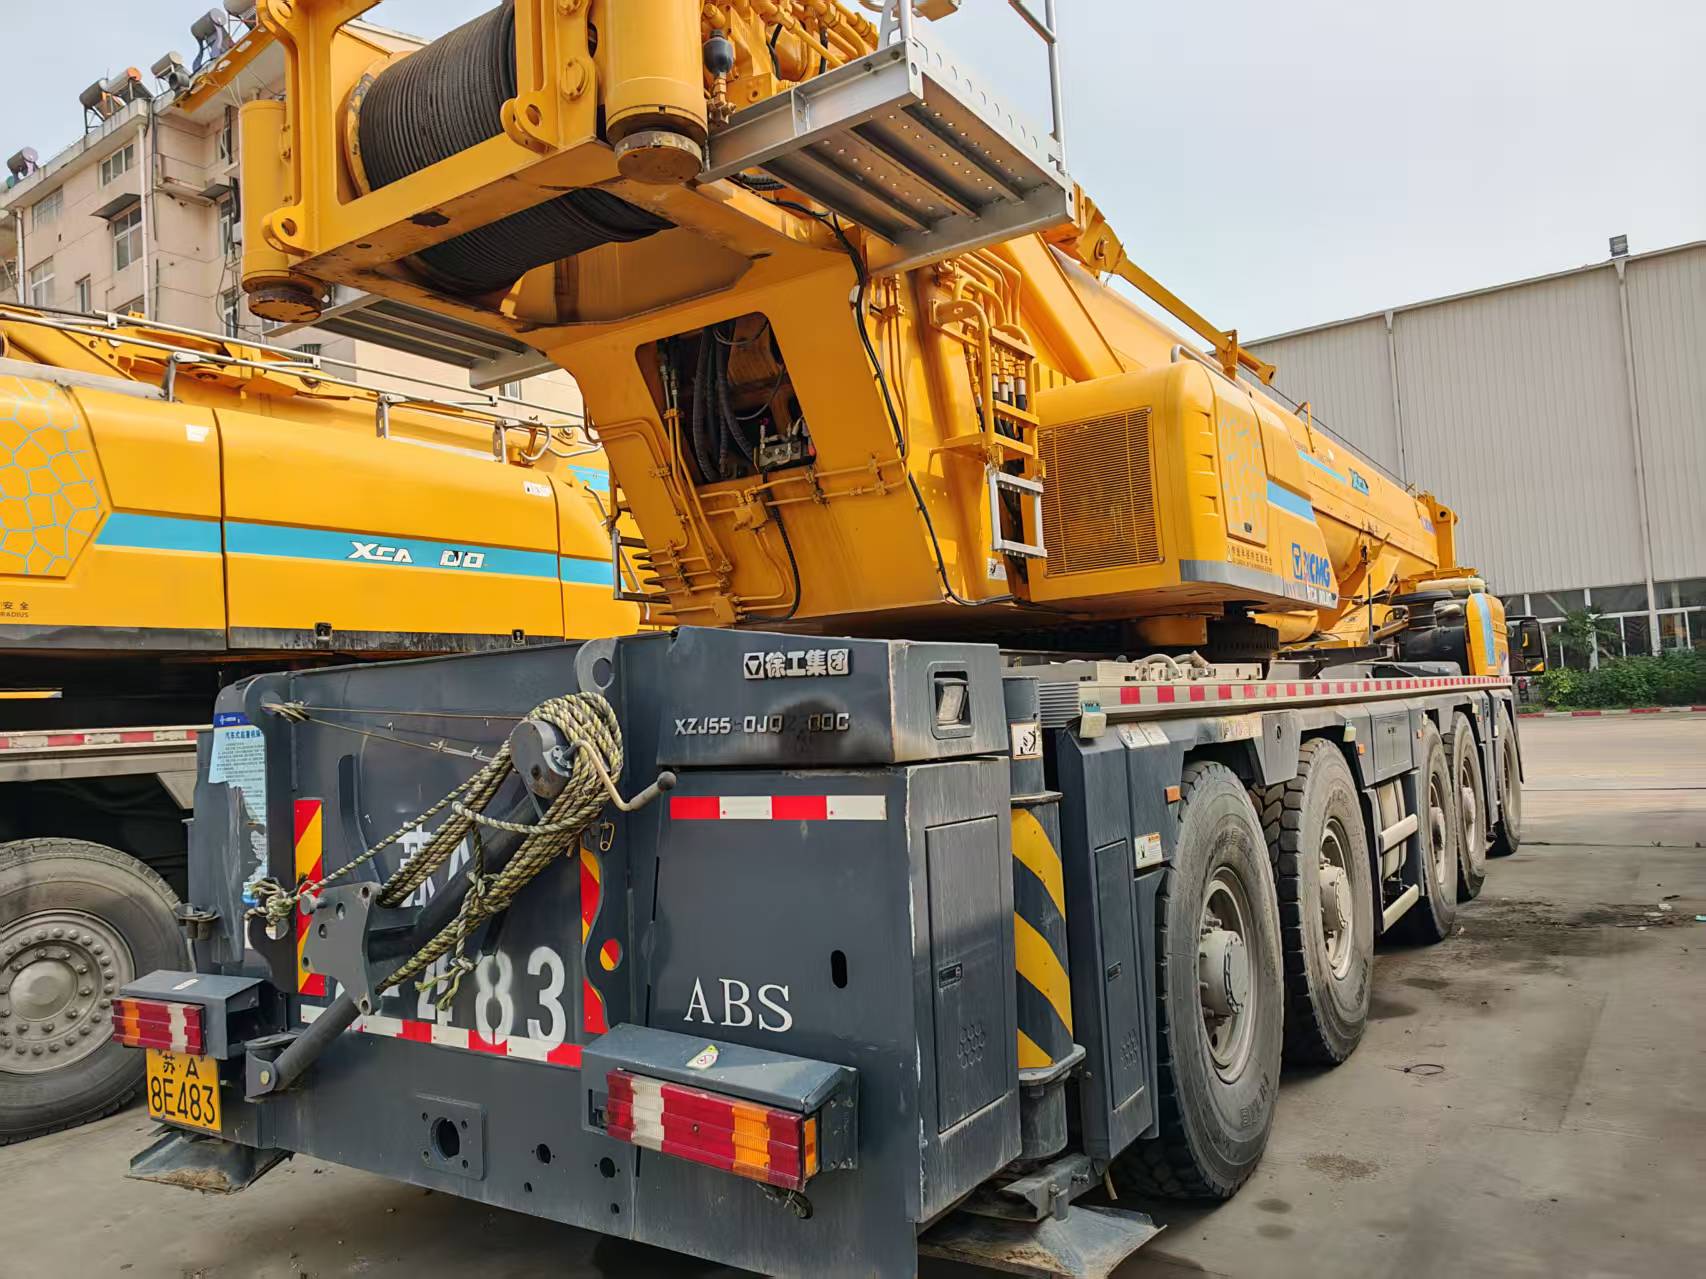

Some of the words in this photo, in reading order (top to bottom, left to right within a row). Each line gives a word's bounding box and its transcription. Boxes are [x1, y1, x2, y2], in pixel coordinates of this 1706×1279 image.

[765, 648, 850, 678] 徐工集团
[683, 976, 793, 1033] ABS
[150, 1076, 215, 1125] 8E483
